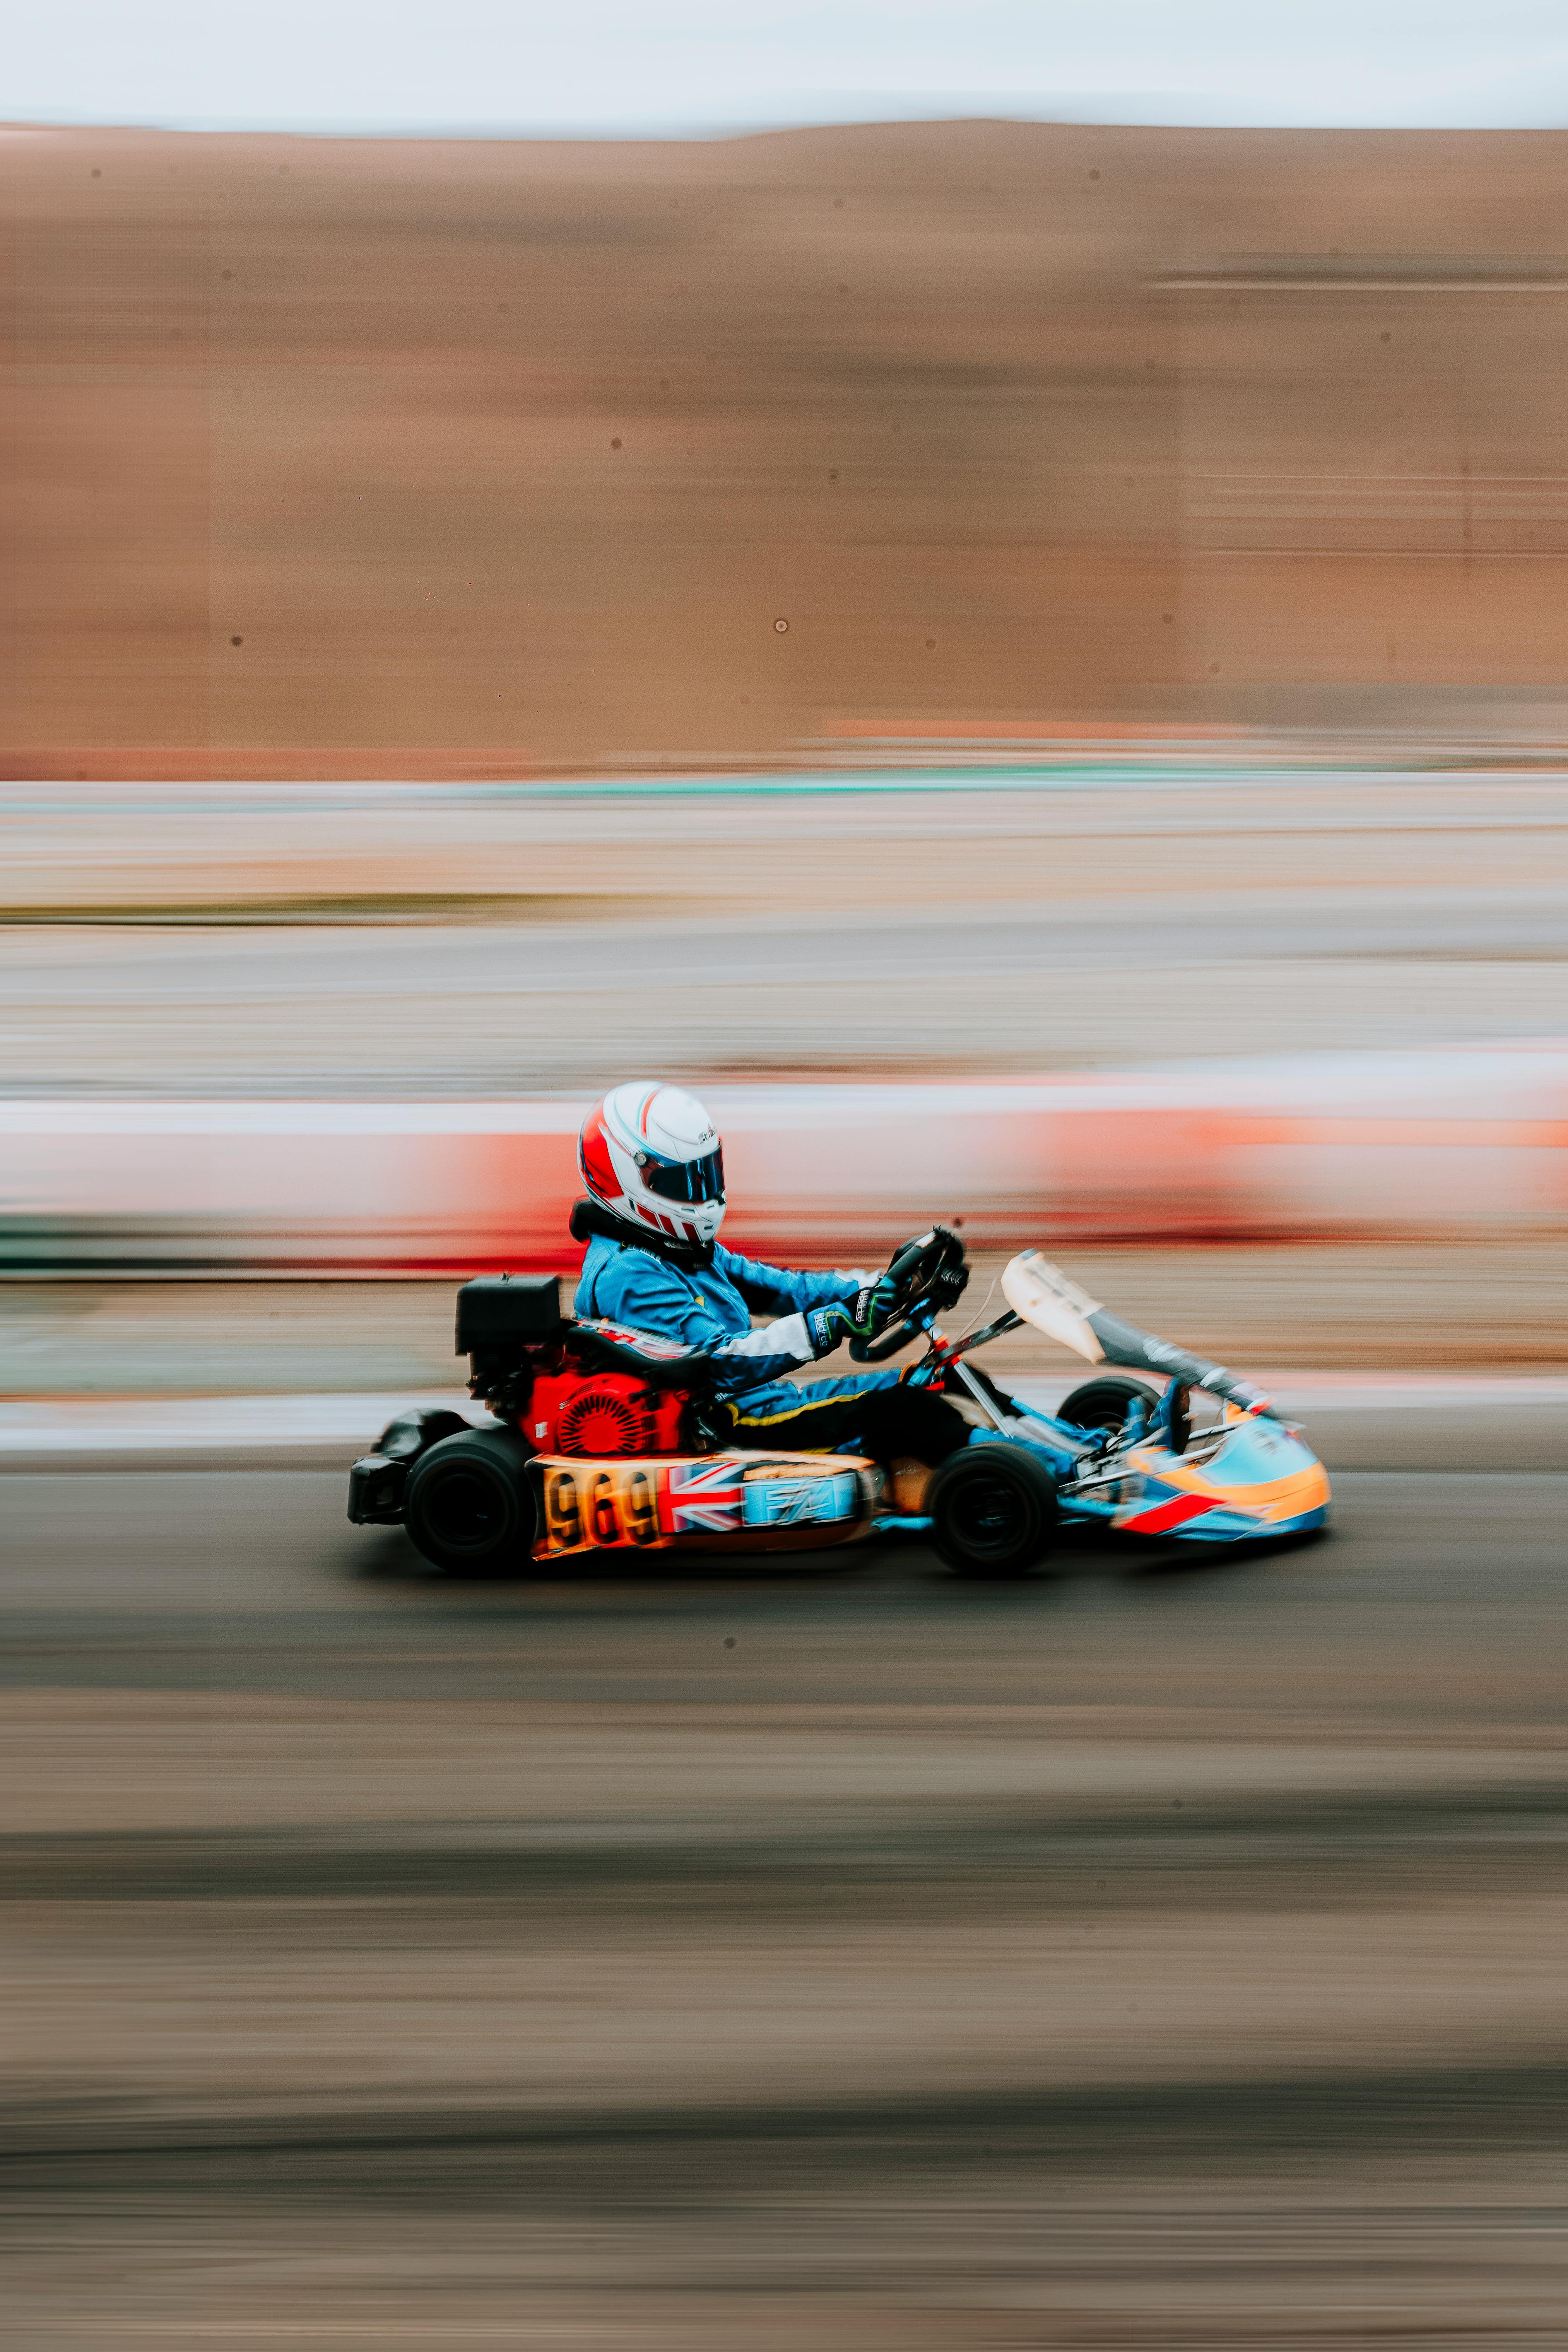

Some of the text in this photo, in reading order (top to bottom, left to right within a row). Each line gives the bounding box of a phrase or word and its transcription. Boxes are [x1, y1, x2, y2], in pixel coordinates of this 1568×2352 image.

[856, 1289, 870, 1322] sparco
[814, 1312, 828, 1347] sparco
[549, 1472, 656, 1547] 969
